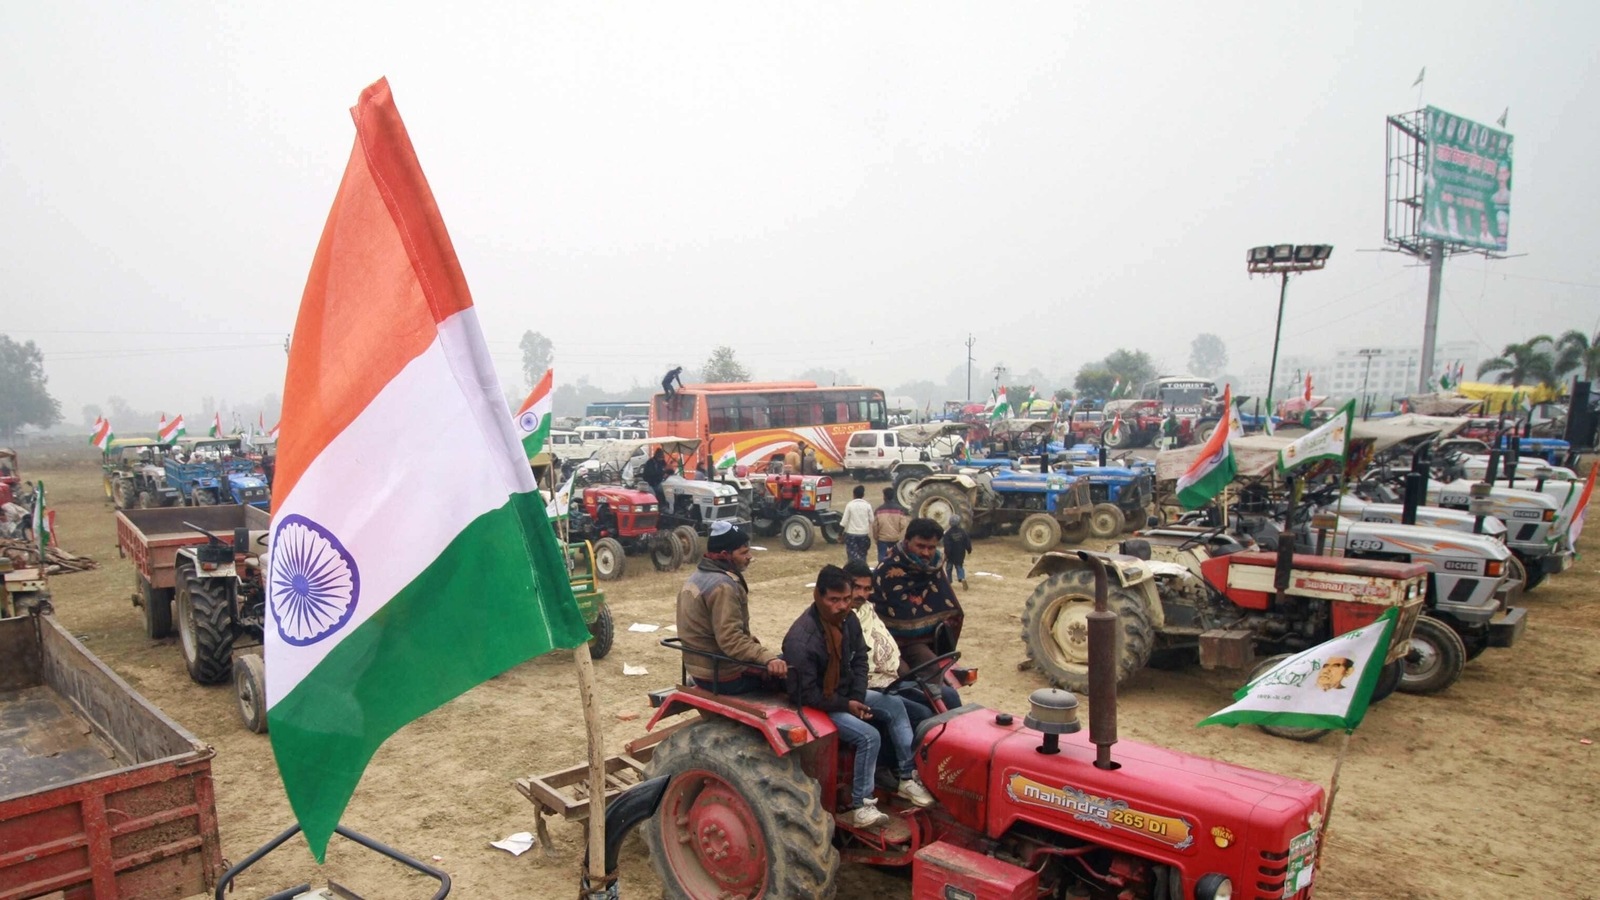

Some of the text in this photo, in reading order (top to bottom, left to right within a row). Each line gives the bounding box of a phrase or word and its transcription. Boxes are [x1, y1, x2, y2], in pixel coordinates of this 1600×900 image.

[1352, 540, 1382, 549] 380
[1023, 784, 1167, 835] Mahindra 265 DI
